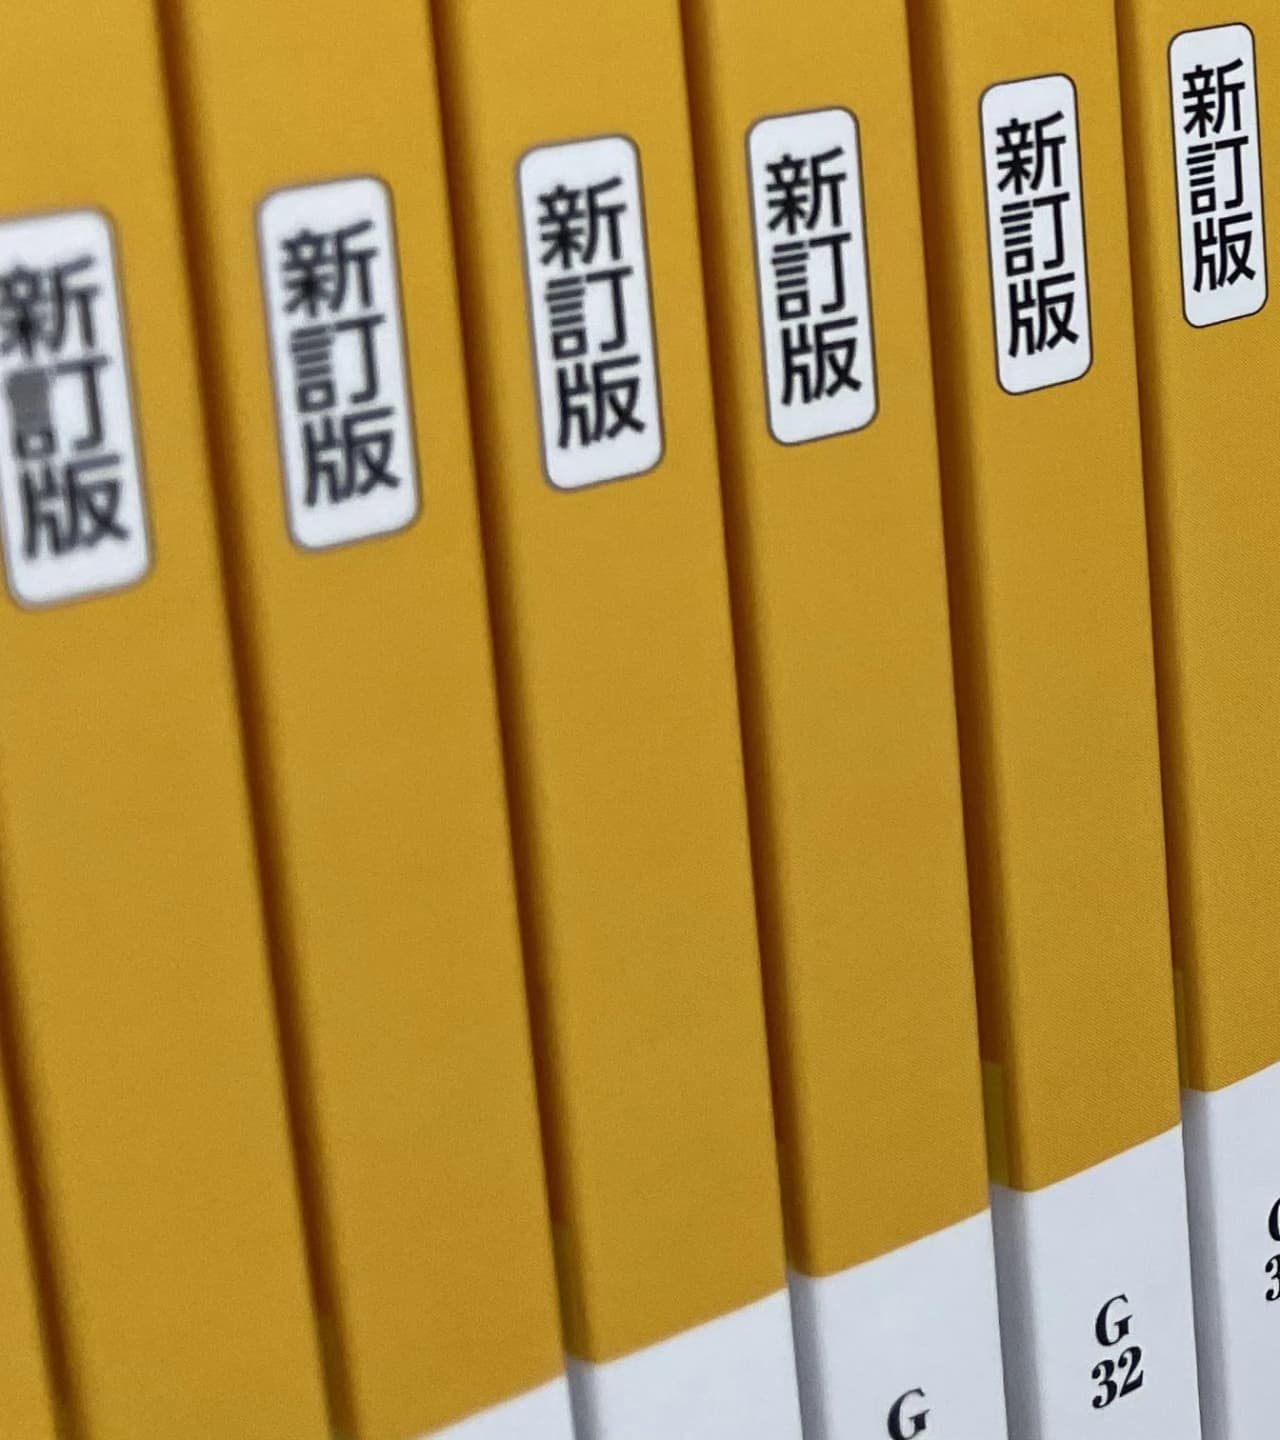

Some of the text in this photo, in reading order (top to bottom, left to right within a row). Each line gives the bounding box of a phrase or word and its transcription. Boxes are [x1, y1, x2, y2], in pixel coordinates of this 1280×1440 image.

[765, 146, 862, 406] 新訂版
[995, 110, 1079, 357] 新訂版
[1181, 57, 1256, 292] 新訂版
[0, 253, 131, 560] 新訂版
[279, 219, 401, 508] 新訂版
[536, 177, 646, 450] 新訂版
[886, 1387, 931, 1440] G
[1090, 1346, 1145, 1409] 32
[1094, 1293, 1132, 1347] G
